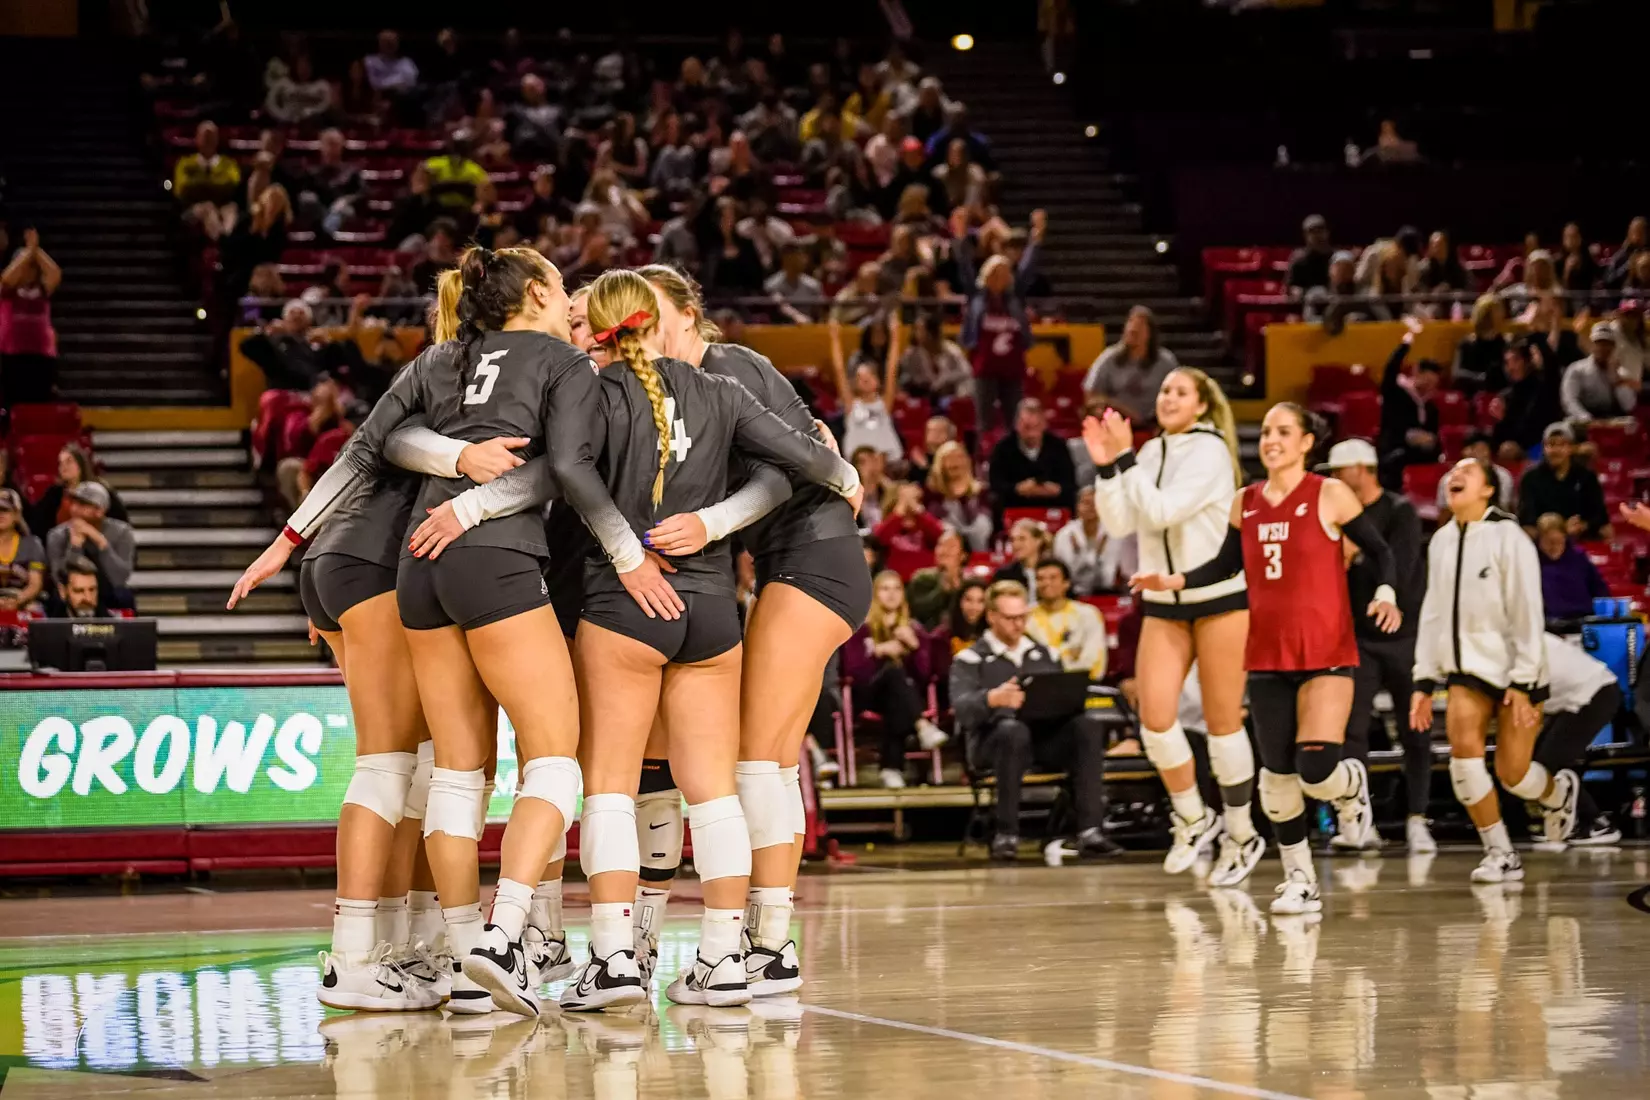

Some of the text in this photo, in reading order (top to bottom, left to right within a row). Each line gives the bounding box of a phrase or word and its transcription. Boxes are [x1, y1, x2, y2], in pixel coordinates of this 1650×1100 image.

[463, 348, 509, 405] 5
[657, 396, 692, 463] 4
[1257, 521, 1290, 543] WSU
[1263, 543, 1283, 580] 3
[18, 712, 323, 798] GROWS
